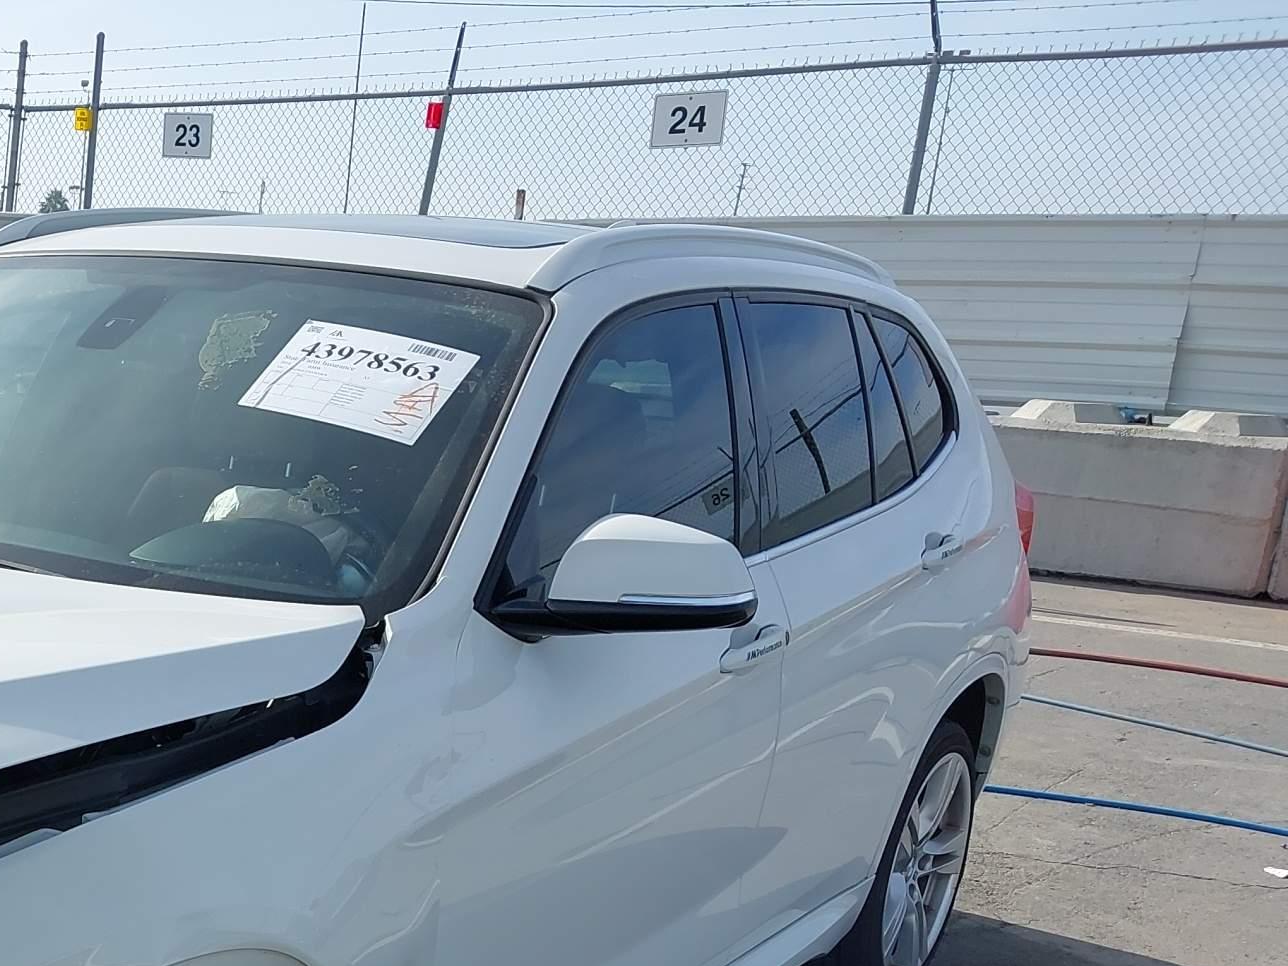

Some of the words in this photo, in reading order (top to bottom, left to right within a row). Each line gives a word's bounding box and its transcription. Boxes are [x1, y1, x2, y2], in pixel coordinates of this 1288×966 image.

[668, 105, 706, 134] 24
[175, 124, 200, 147] 23
[301, 341, 440, 381] 43978563
